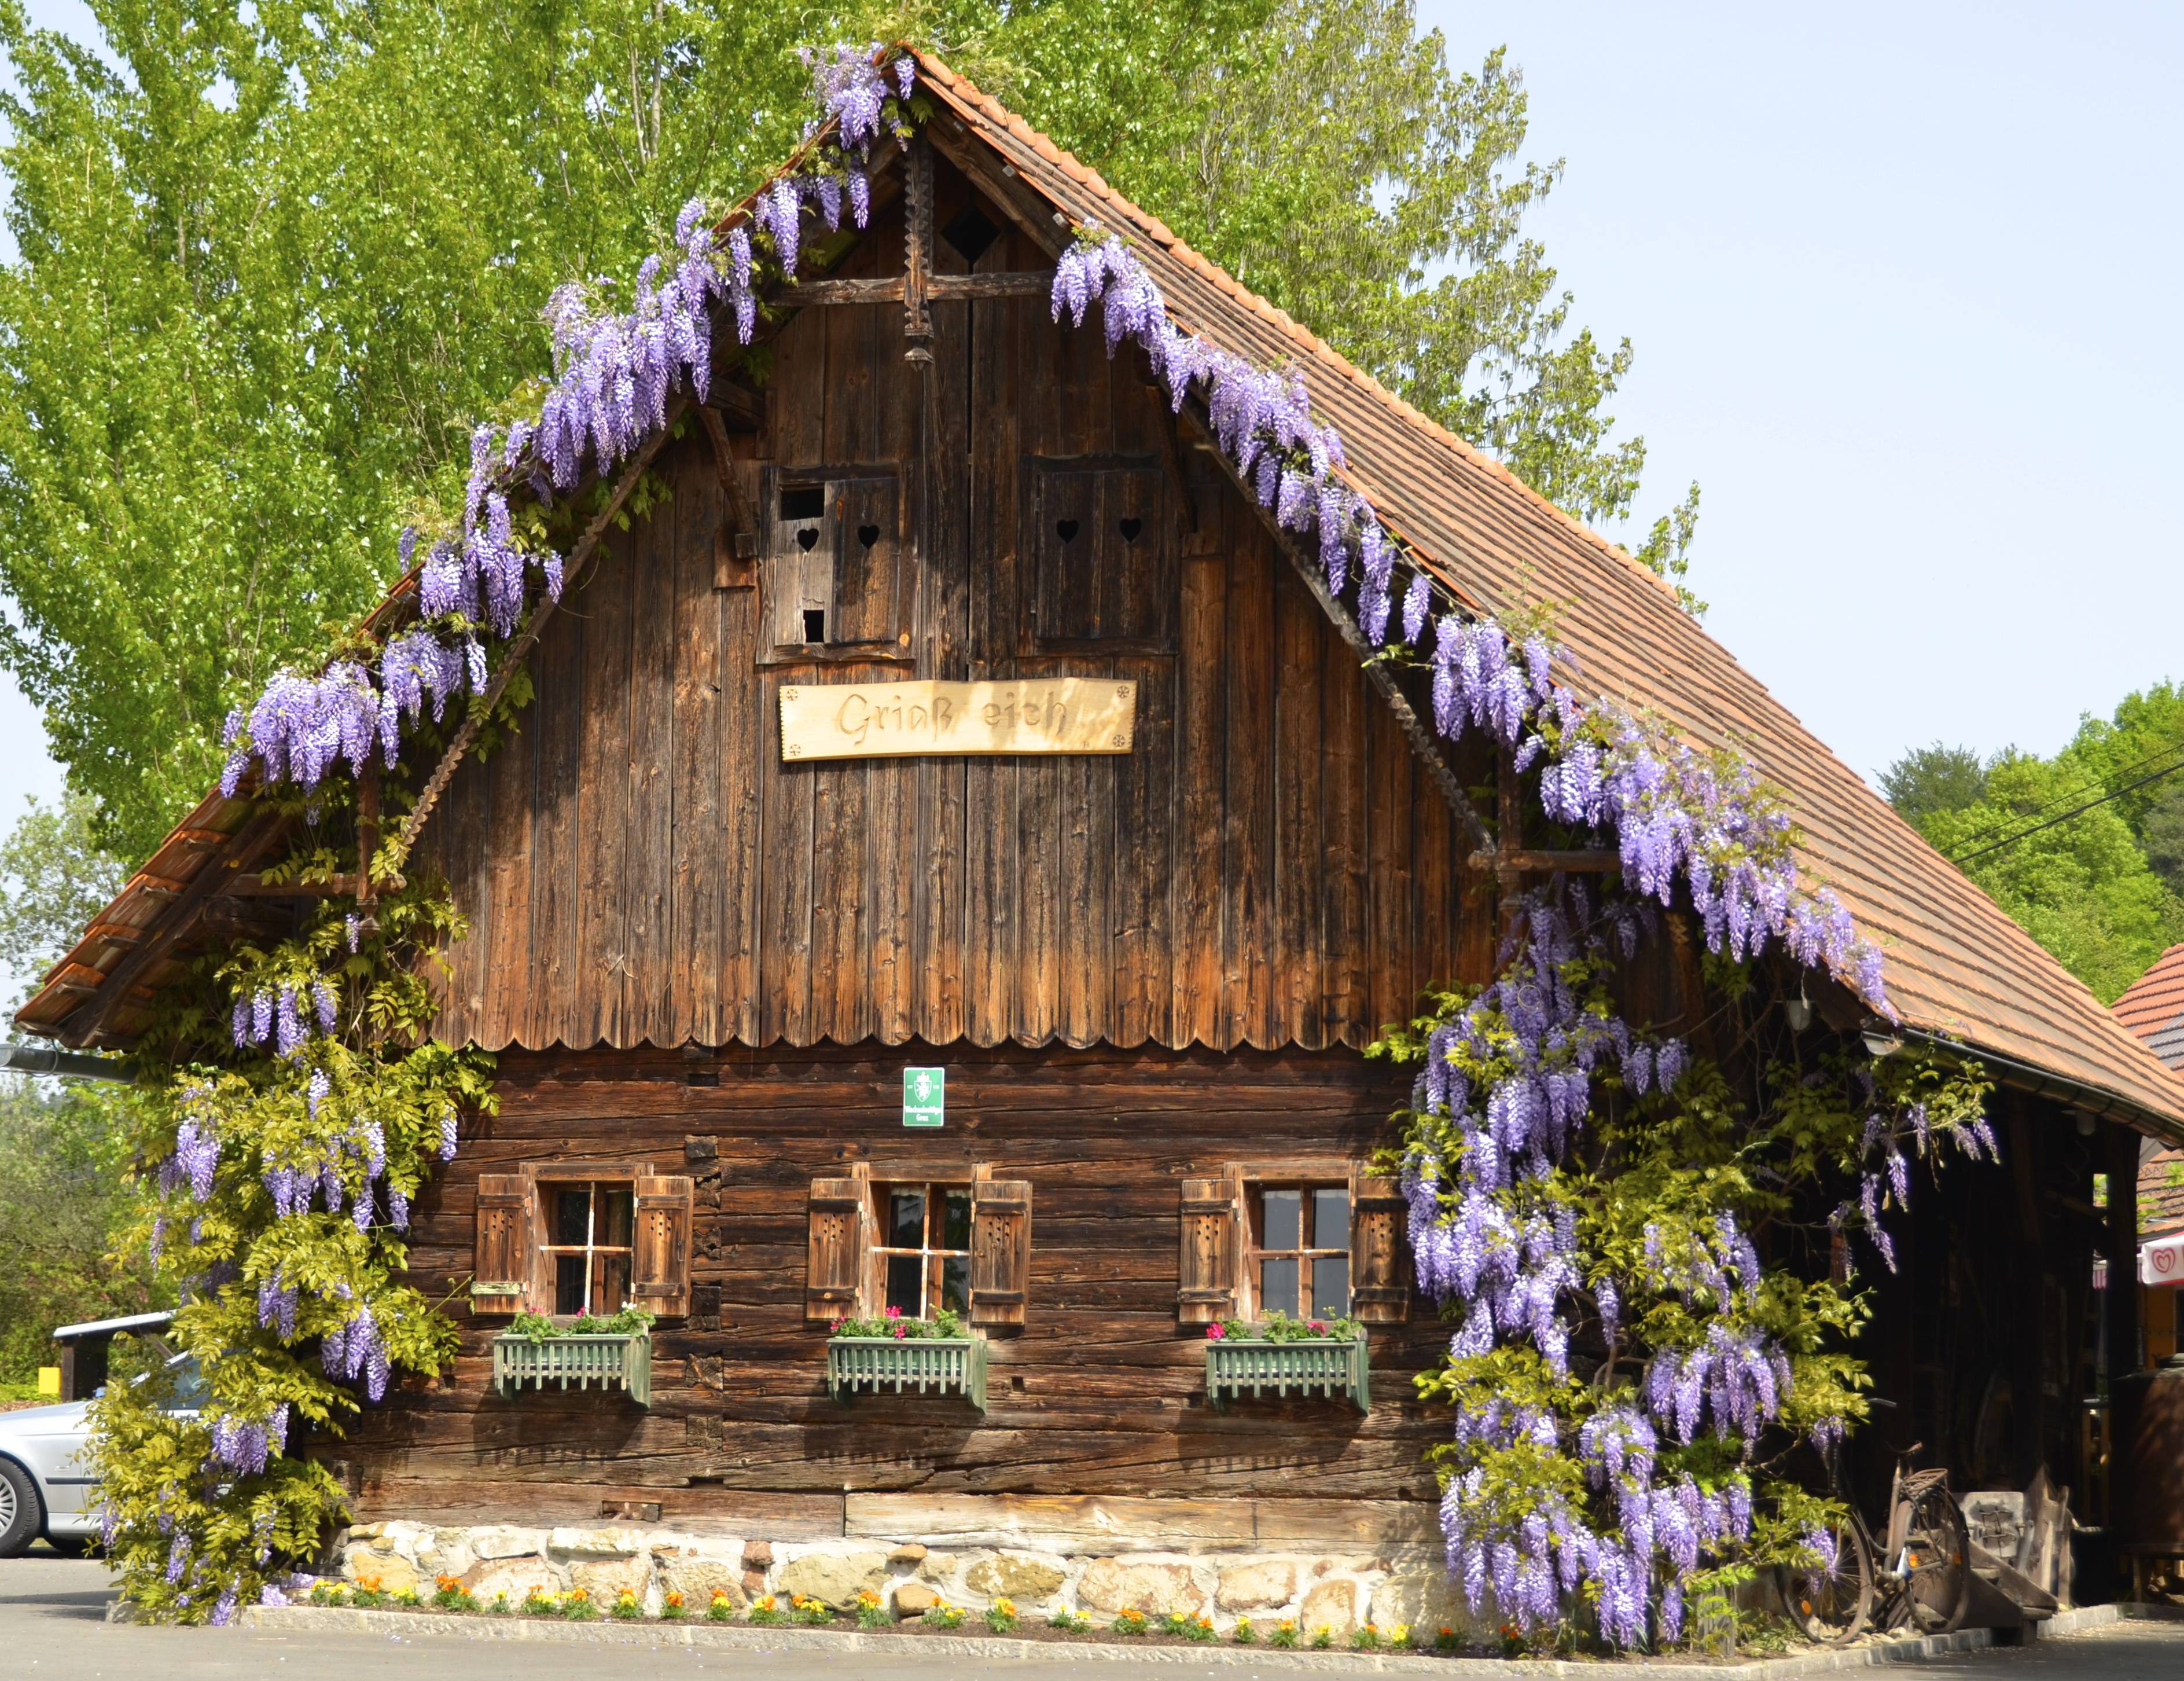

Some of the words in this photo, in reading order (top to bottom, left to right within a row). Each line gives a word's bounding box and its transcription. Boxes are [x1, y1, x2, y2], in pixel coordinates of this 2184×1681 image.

[836, 693, 953, 747] Griaß
[981, 691, 1067, 736] eich
[916, 1113, 929, 1121] Graz
